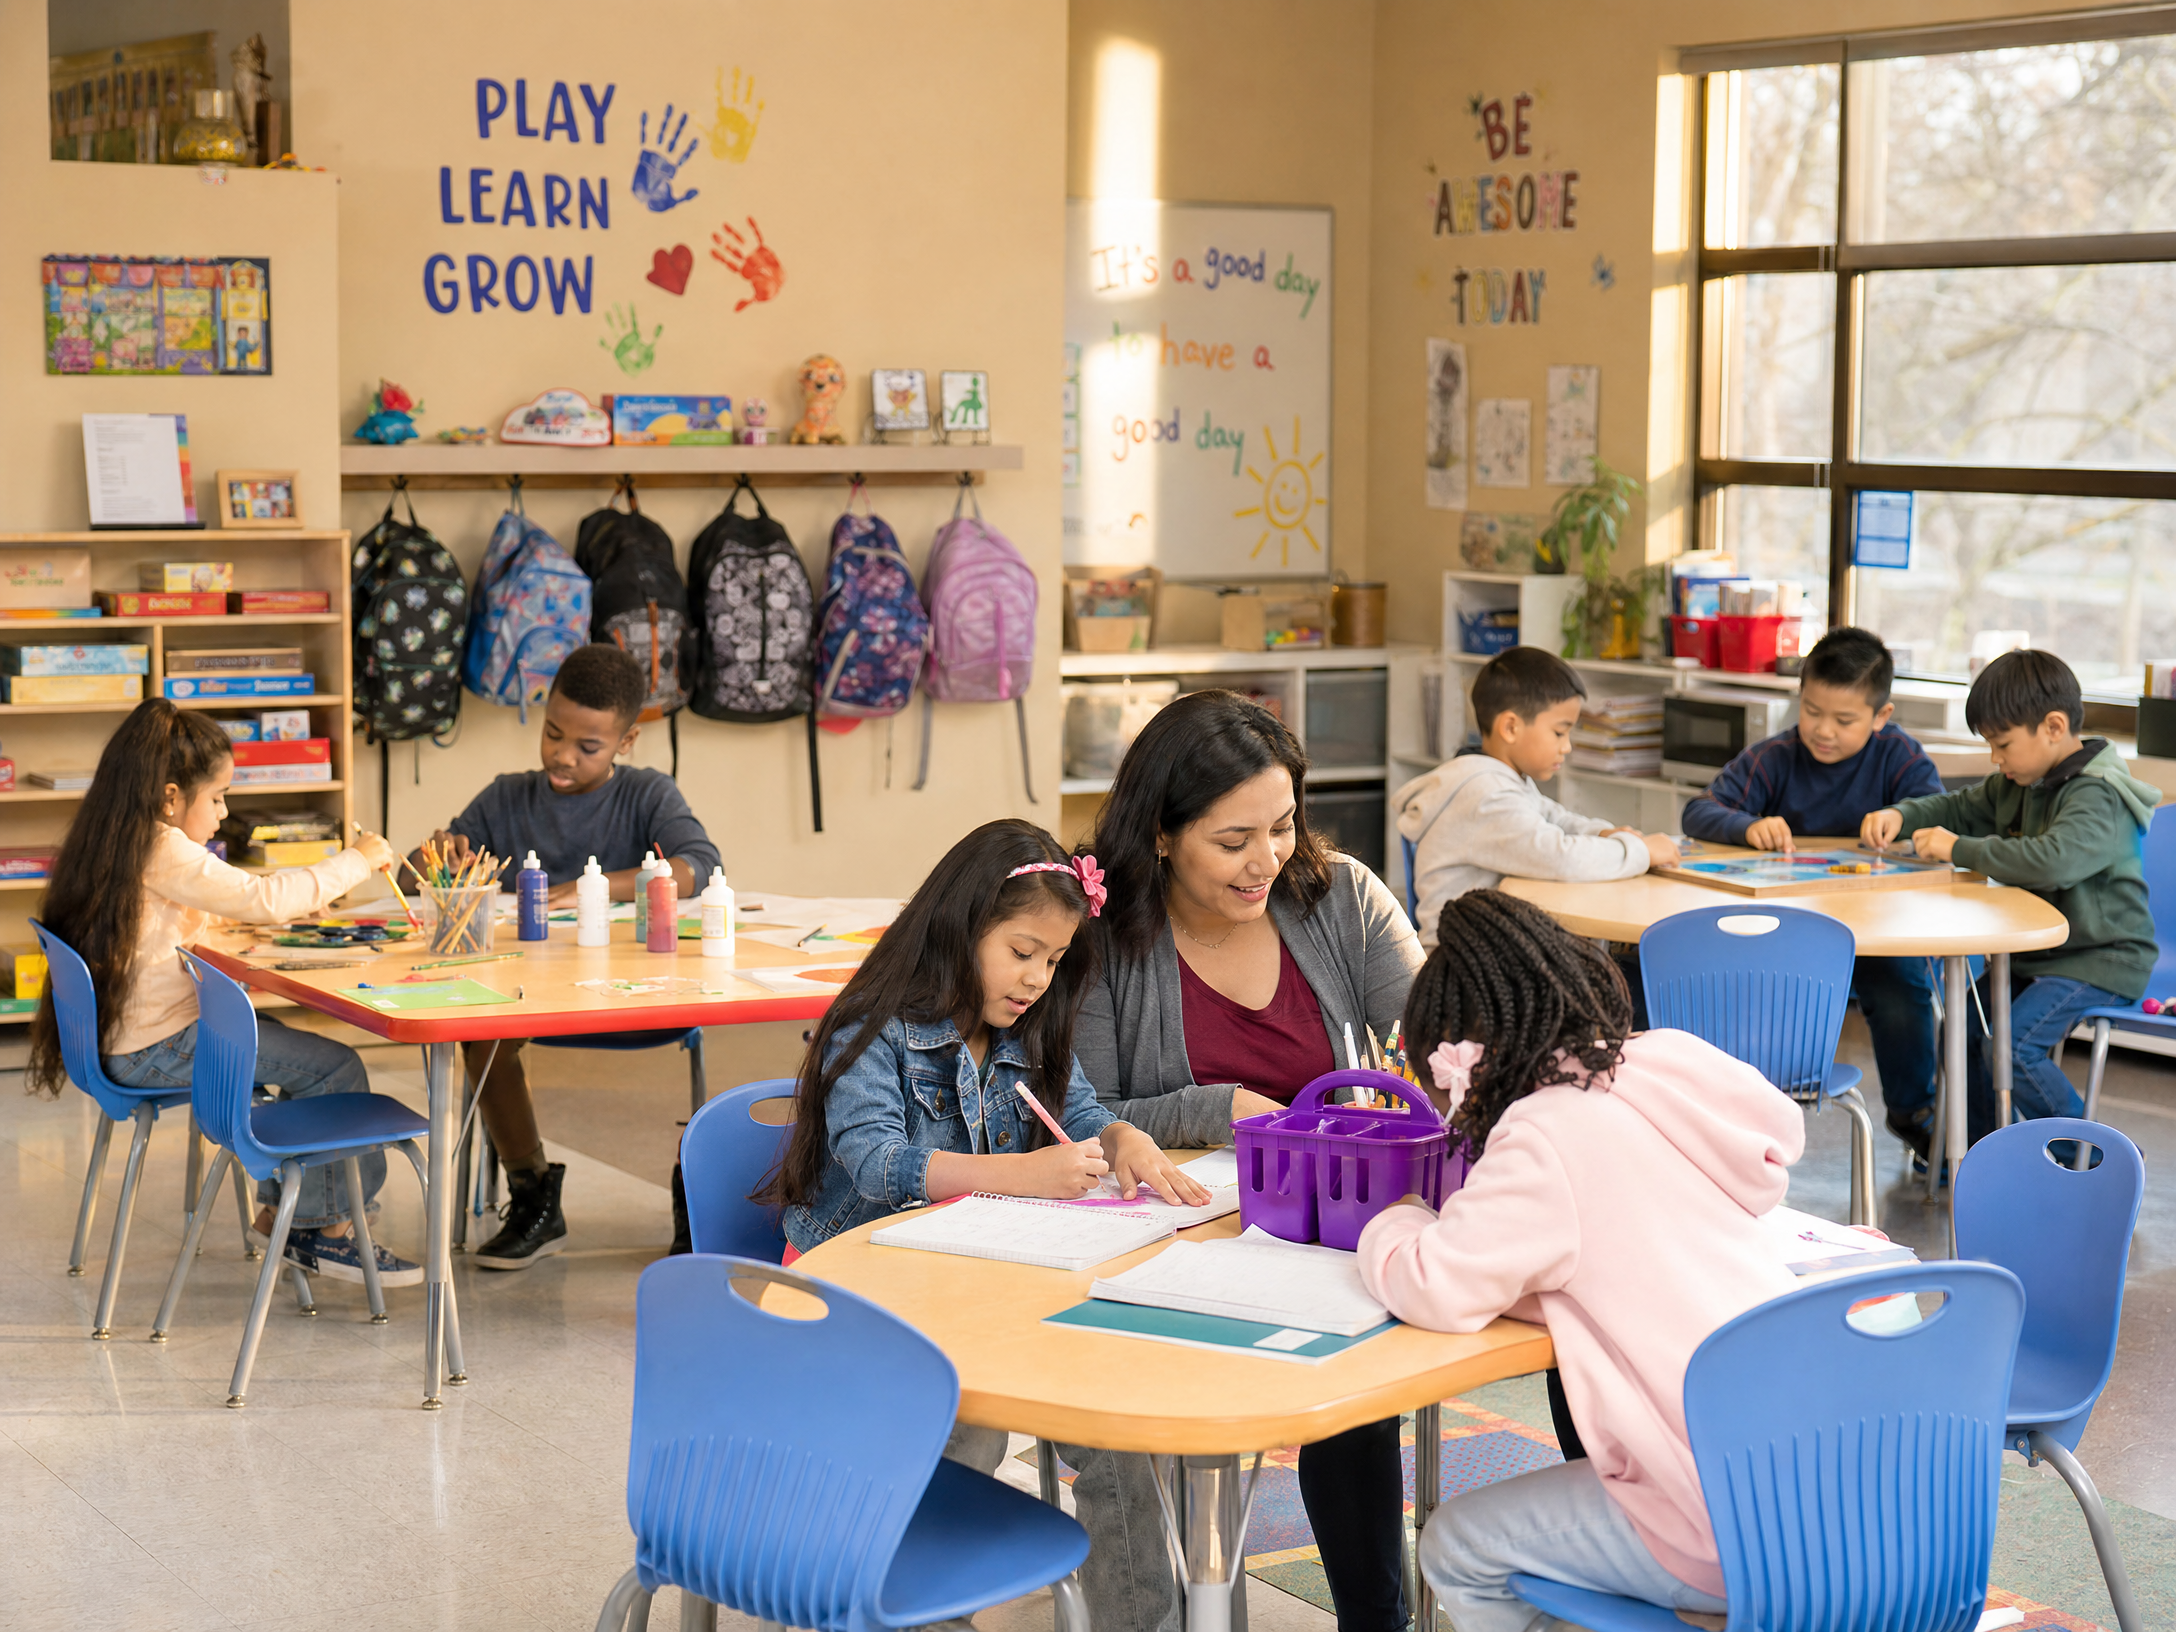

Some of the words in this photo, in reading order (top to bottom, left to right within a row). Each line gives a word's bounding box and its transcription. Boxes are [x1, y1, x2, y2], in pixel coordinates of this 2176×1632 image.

[476, 78, 615, 144] PLAY
[1481, 94, 1533, 161] BE
[440, 166, 609, 230] LEARN
[1435, 172, 1578, 235] AWESOME
[423, 253, 593, 316] GROW
[1090, 245, 1160, 292] It's
[1171, 257, 1196, 284] a
[1203, 246, 1266, 291] good
[1273, 251, 1321, 320] day
[1453, 268, 1545, 325] TODAY
[1109, 318, 1143, 361] to
[1160, 321, 1236, 372] have
[1253, 344, 1276, 372] a
[1112, 406, 1181, 462] good
[1195, 410, 1245, 477] day
